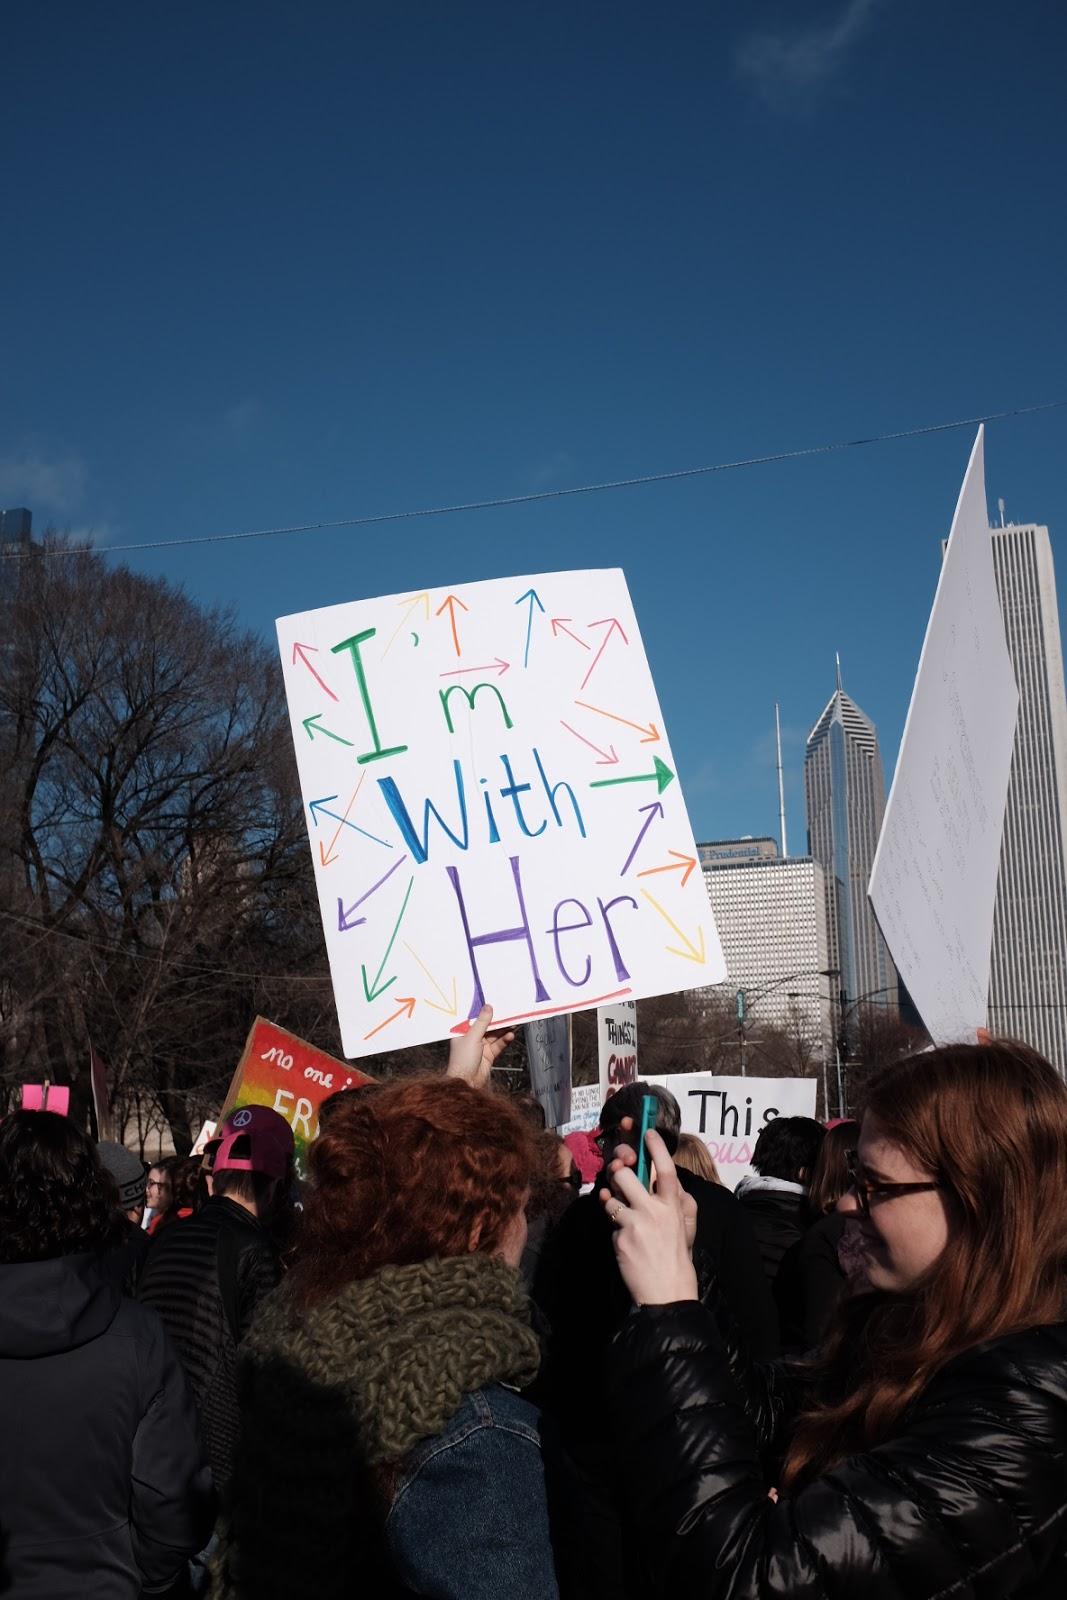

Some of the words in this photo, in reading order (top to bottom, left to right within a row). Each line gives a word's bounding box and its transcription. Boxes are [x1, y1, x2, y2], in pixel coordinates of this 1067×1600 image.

[330, 627, 514, 764] I'm
[376, 748, 587, 864] With
[446, 856, 639, 1020] Her
[260, 1047, 294, 1071] no
[304, 1067, 333, 1088] one
[688, 1090, 780, 1137] This
